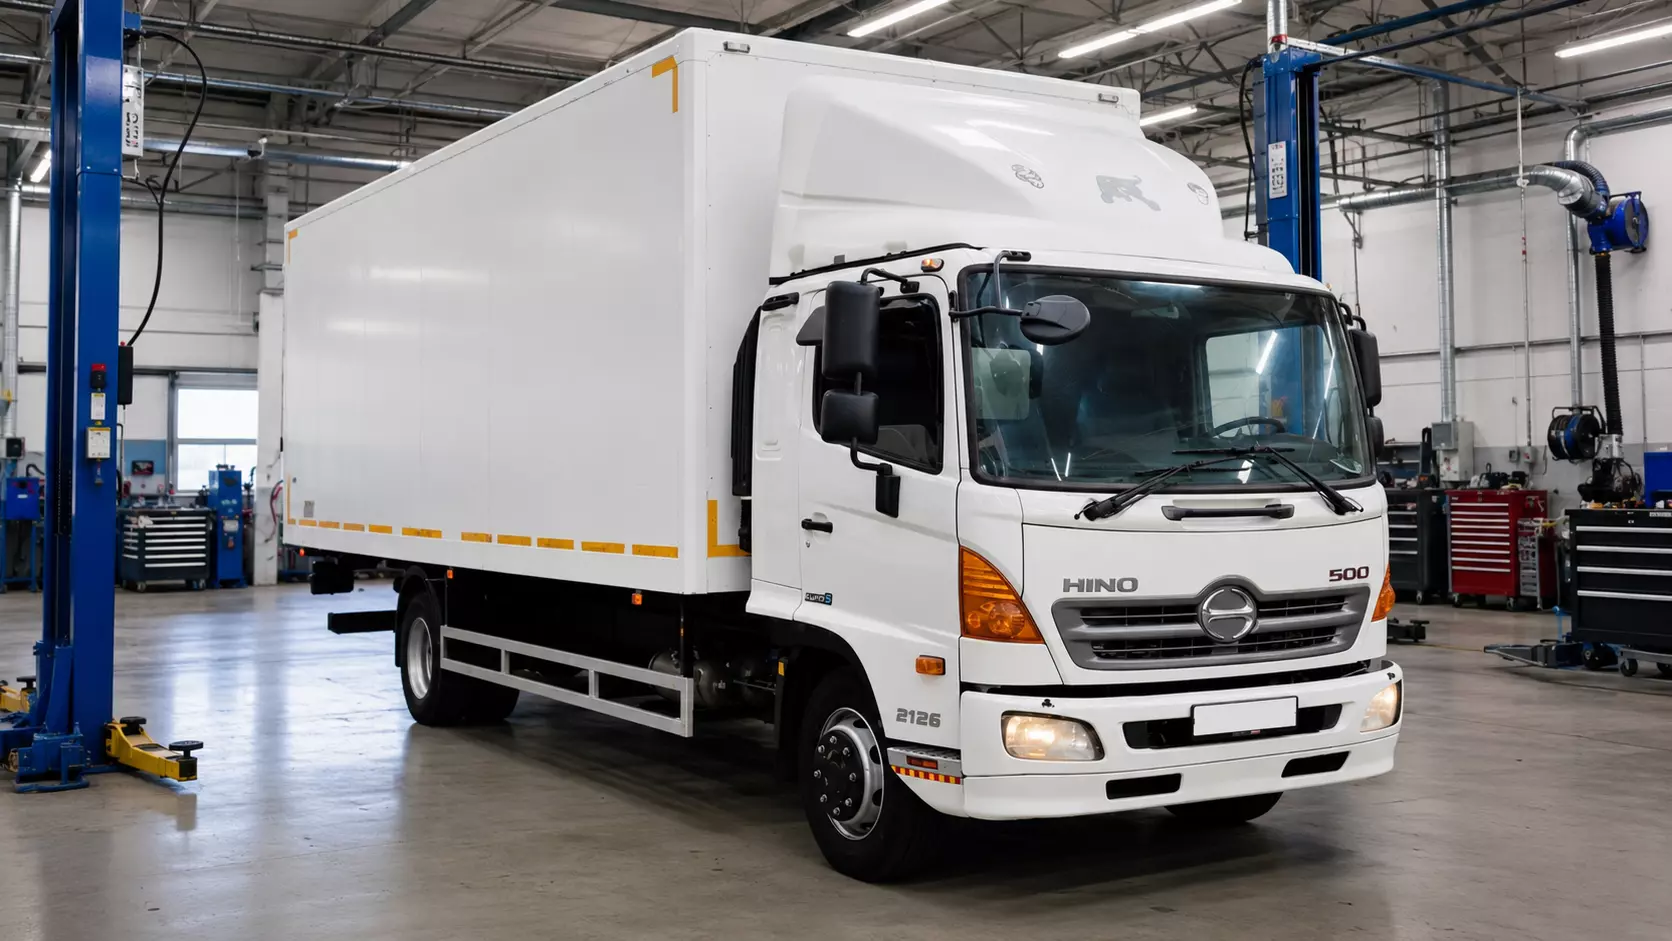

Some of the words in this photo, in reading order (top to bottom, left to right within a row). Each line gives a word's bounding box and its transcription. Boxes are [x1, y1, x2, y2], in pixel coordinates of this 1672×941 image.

[1329, 566, 1370, 582] 500
[1062, 577, 1139, 593] HINO
[895, 707, 941, 728] 2126
